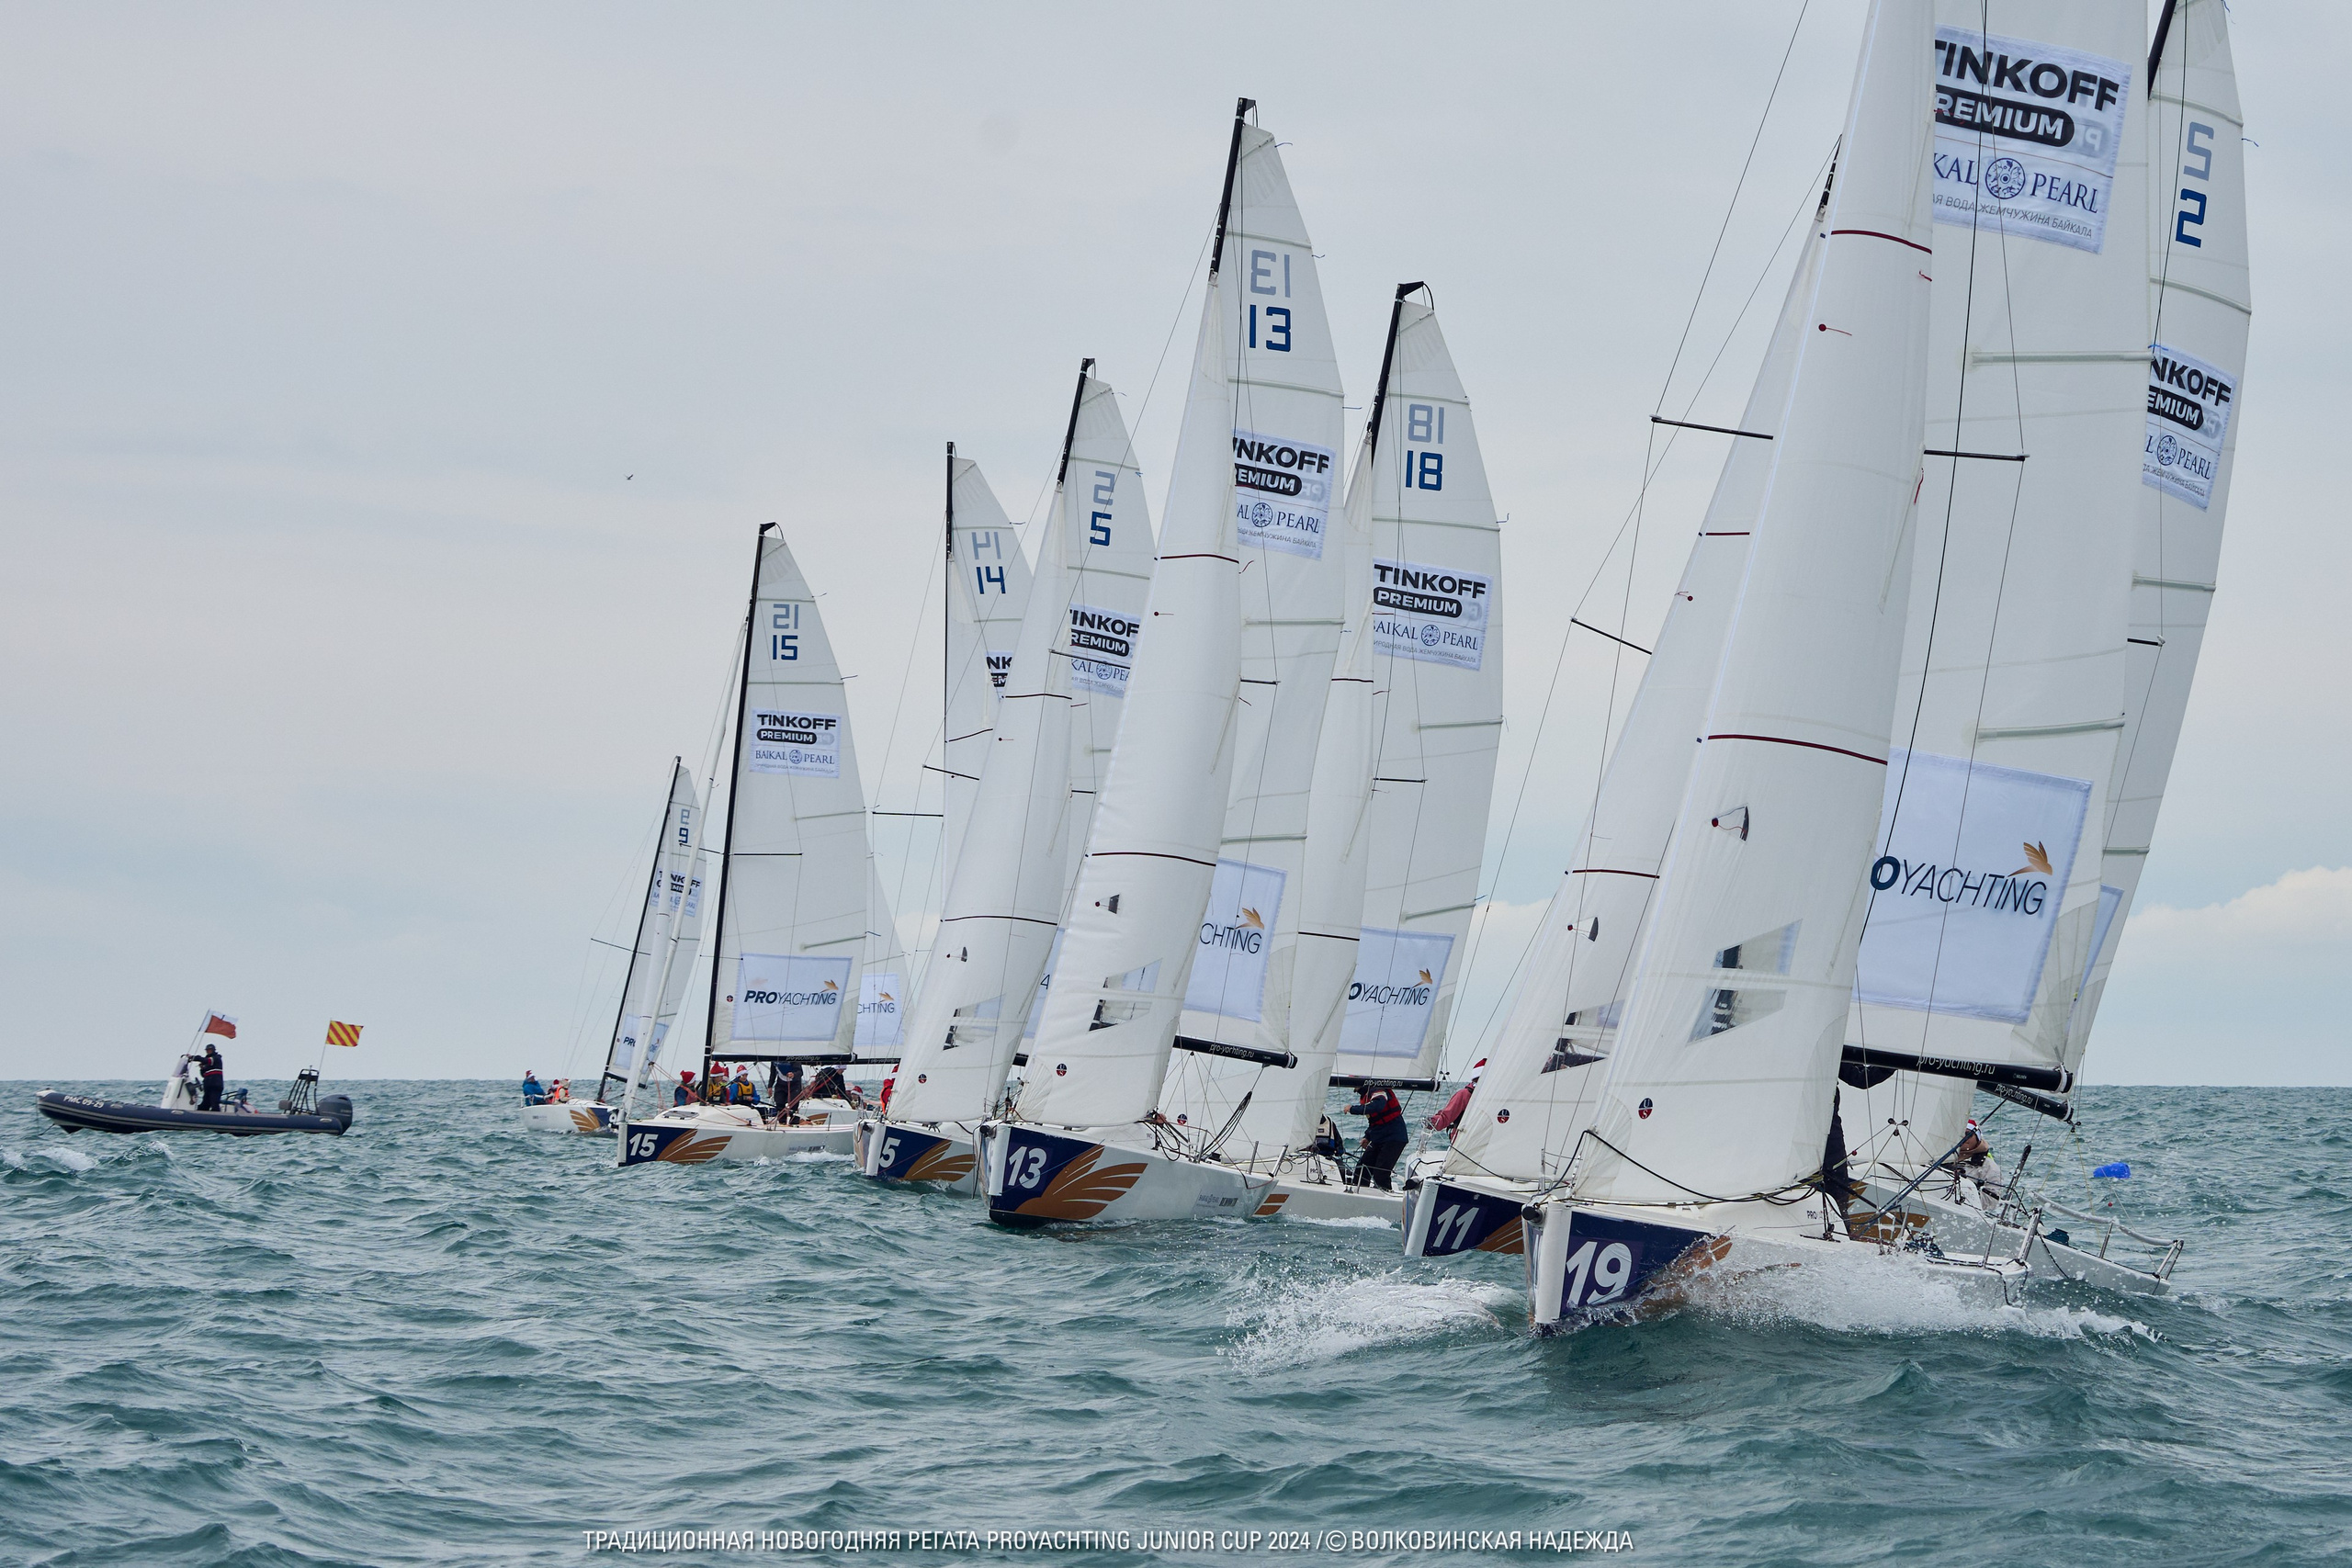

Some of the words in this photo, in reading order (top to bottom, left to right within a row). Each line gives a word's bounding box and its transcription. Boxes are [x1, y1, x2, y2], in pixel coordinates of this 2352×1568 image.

[2030, 172, 2098, 213] PEARL
[1945, 197, 1975, 212] ВОДА
[1977, 203, 2051, 227] ЖЕМЧУЖИНА
[2052, 217, 2092, 239] БАЙКАЛА
[2175, 187, 2207, 247] 2
[1250, 304, 1291, 352] 13
[1405, 450, 1442, 491] 18
[2177, 448, 2211, 479] PEARL
[1236, 468, 1295, 492] EMIUM
[1090, 511, 1112, 547] 5
[1276, 511, 1319, 534] PEARL
[976, 566, 1006, 594] 14
[1374, 563, 1487, 599] TINKOFF
[1377, 590, 1457, 615] PREMIUM
[1069, 609, 1139, 637] INKOF
[772, 635, 798, 660] 15
[1442, 630, 1478, 650] PEARL
[756, 714, 837, 730] TINKOFF
[761, 730, 813, 742] PREMIUM
[755, 750, 787, 761] BAIKAL
[804, 753, 835, 764] PEARL
[1199, 921, 1262, 954] CHTING
[744, 990, 838, 1006] PROYACHTING
[628, 1133, 657, 1157] 15
[878, 1137, 901, 1168] 5
[1008, 1146, 1046, 1190] 13
[1432, 1204, 1479, 1250] 11
[1566, 1241, 1633, 1308] 19
